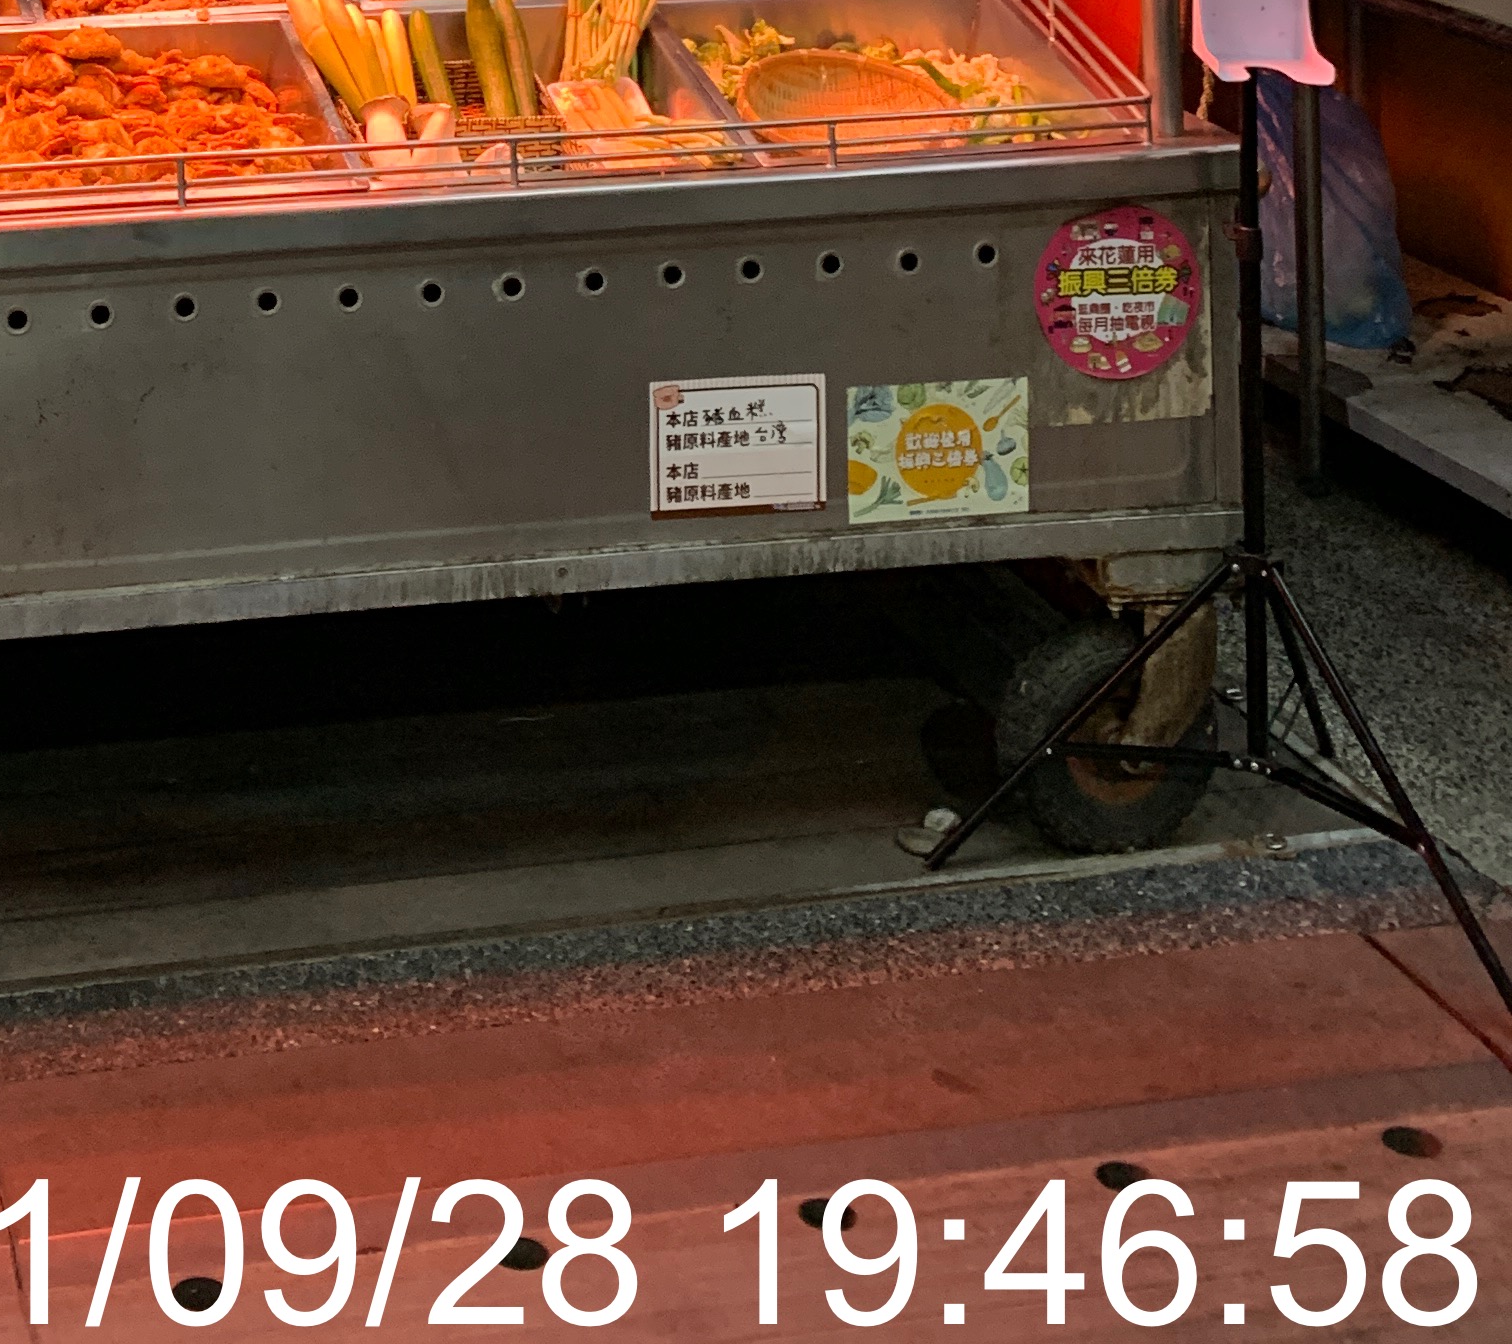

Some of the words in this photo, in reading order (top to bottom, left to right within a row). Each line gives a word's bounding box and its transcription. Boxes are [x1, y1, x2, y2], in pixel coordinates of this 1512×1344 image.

[1078, 245, 1155, 266] 來花蓮用
[1057, 267, 1179, 297] 振興三倍券
[666, 410, 698, 428] 本店
[666, 429, 750, 451] 豬原料產地
[666, 462, 699, 480] 本店
[666, 482, 751, 503] 豬原料產地
